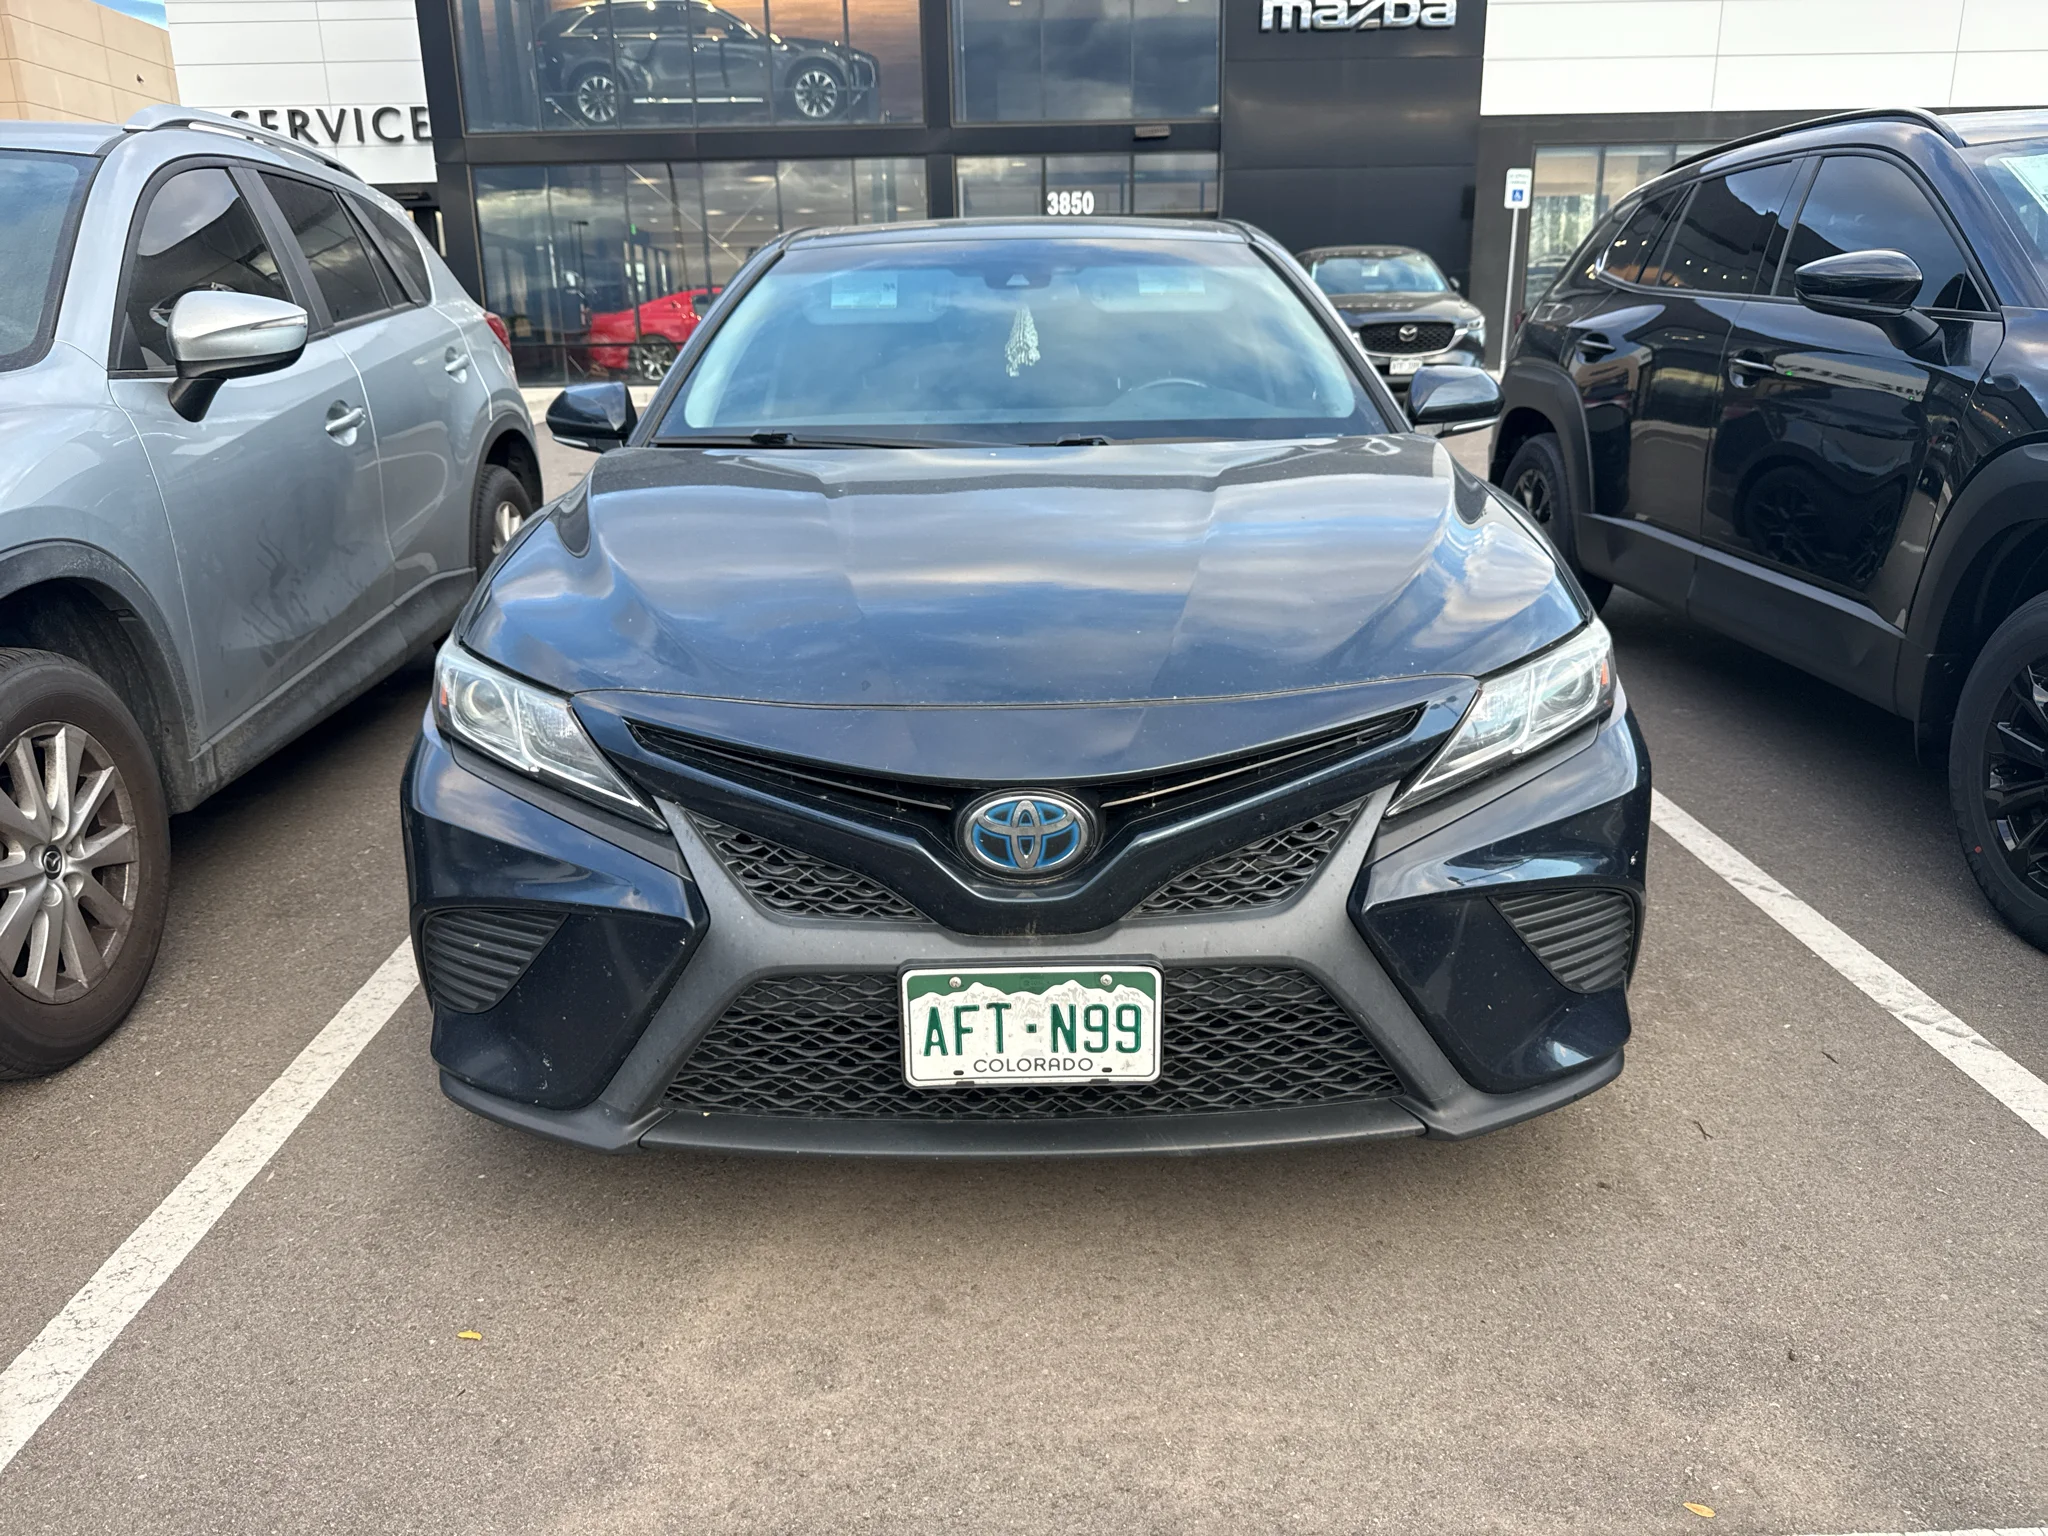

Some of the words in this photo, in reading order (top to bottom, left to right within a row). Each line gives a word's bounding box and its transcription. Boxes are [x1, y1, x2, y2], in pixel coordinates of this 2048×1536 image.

[230, 106, 434, 145] ERVICE
[1047, 190, 1095, 215] 3850
[973, 1057, 1094, 1073] COLORADO
